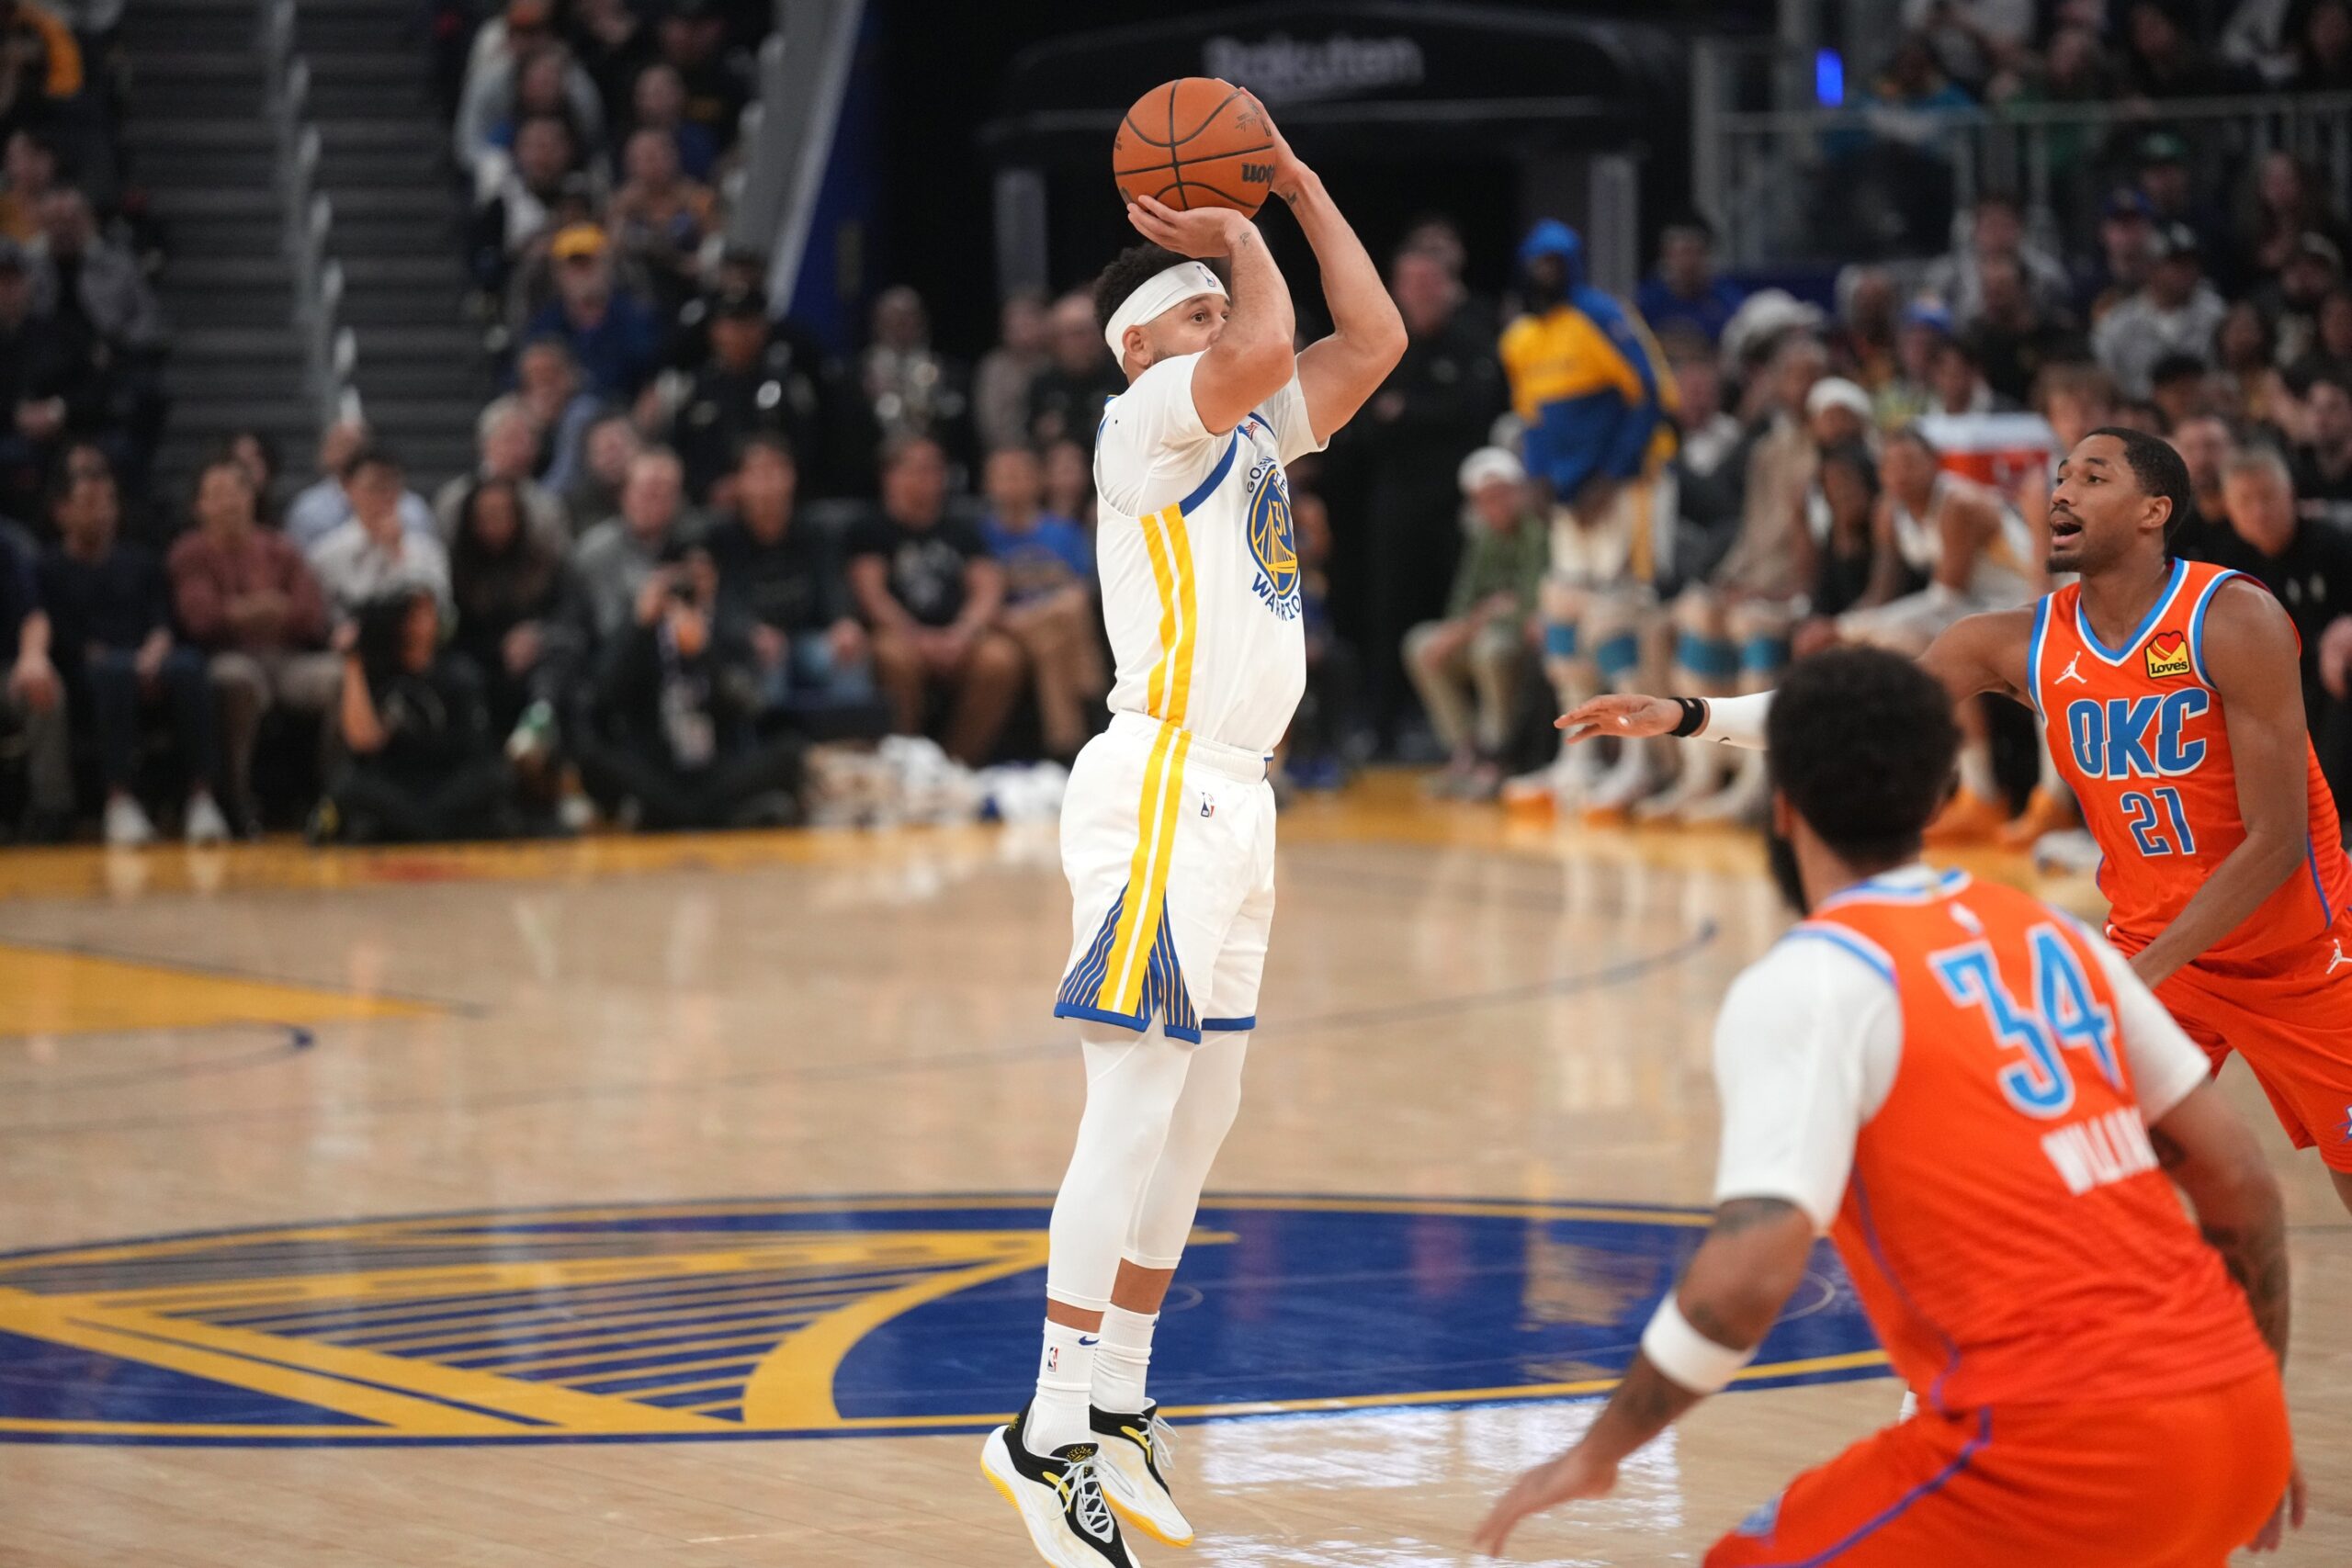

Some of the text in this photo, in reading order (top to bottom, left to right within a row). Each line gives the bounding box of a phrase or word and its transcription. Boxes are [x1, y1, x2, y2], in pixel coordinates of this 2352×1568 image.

[1272, 501, 1287, 536] 31
[1251, 571, 1301, 621] WARRIO
[2066, 686, 2210, 781] OKC
[2120, 786, 2197, 857] 21
[1927, 920, 2125, 1120] 34
